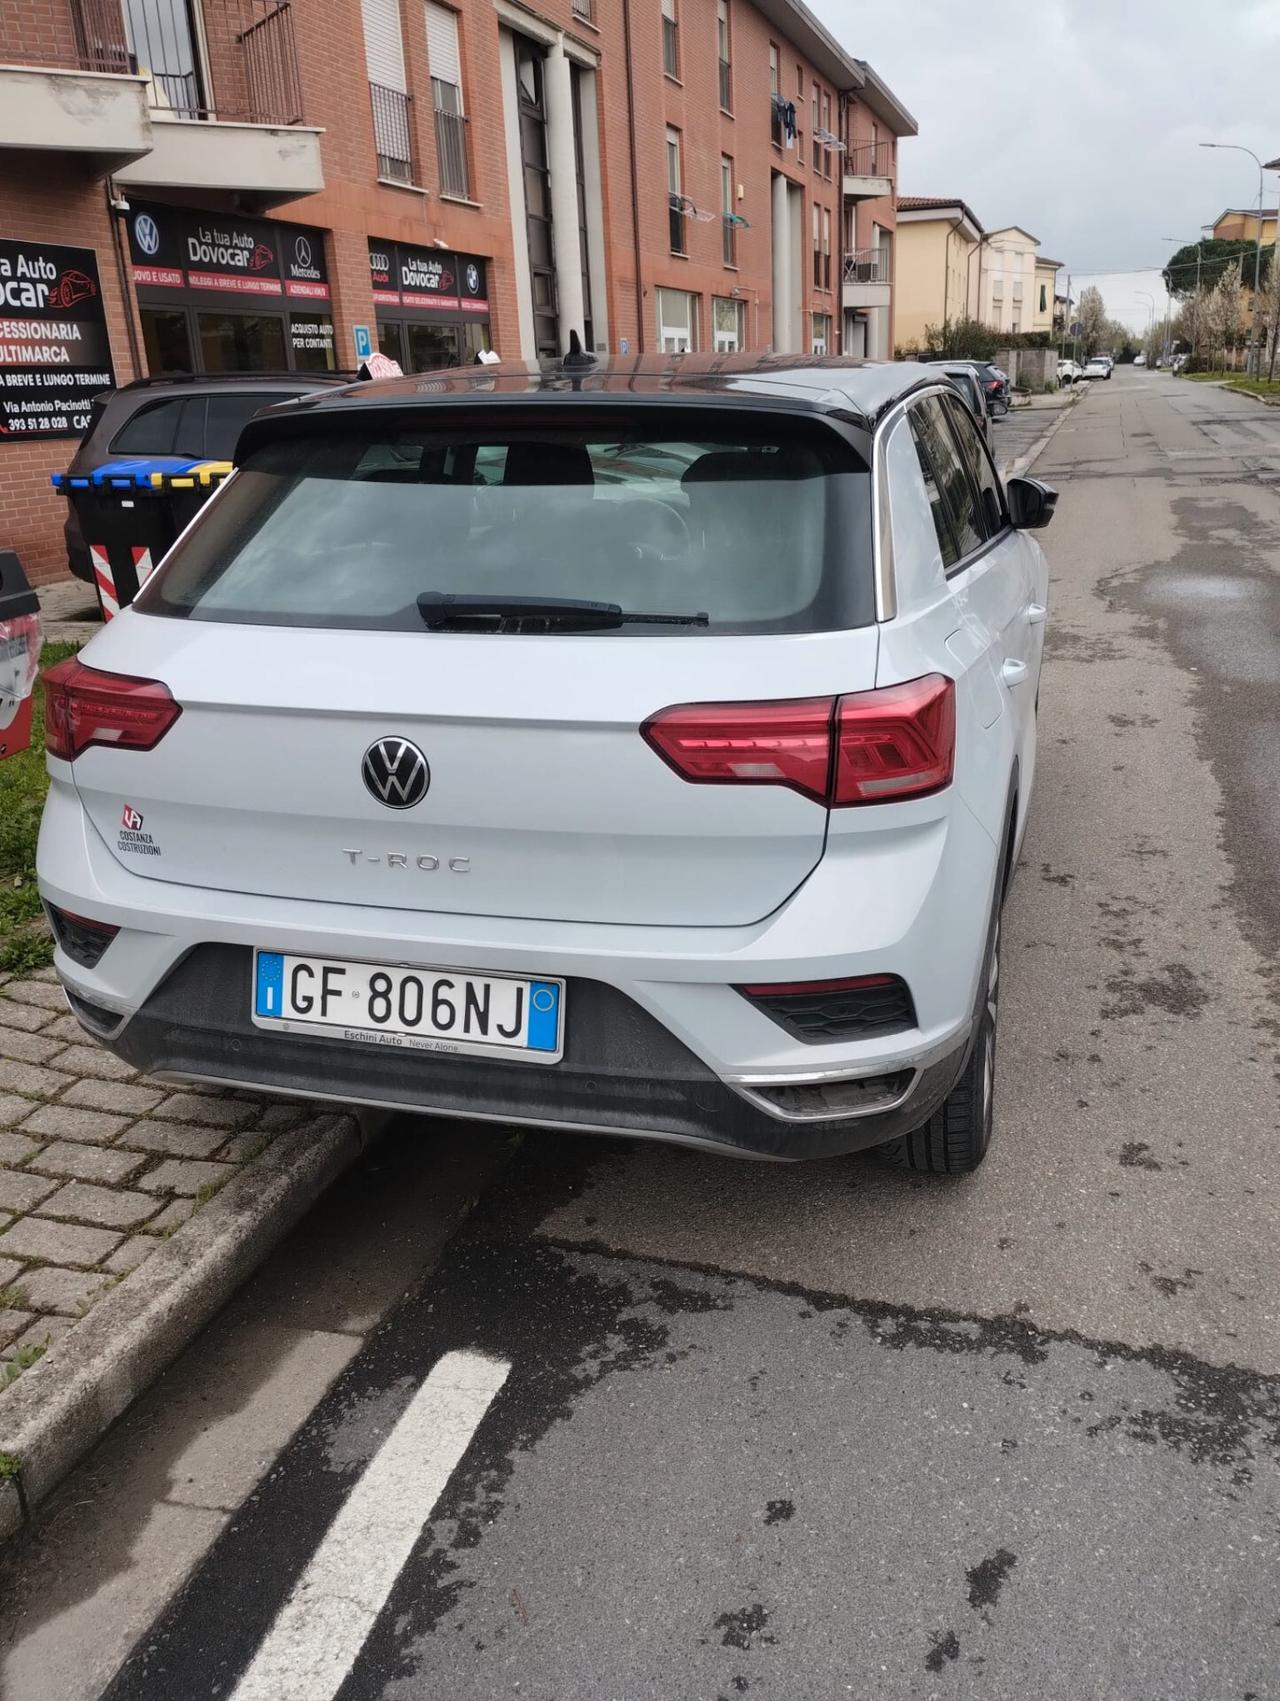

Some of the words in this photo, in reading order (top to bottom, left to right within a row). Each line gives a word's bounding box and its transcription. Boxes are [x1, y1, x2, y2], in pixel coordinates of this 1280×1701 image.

[199, 226, 212, 243] La
[214, 228, 230, 246] tua
[232, 231, 255, 249] Auto
[187, 237, 250, 267] Dovocar
[0, 258, 12, 277] a
[17, 254, 57, 280] Auto
[290, 263, 321, 279] Mercedes
[408, 257, 416, 271] La
[417, 259, 428, 272] tua
[428, 261, 442, 274] Auto
[152, 271, 158, 282] E
[158, 272, 181, 284] USATO
[401, 266, 440, 288] Dovocar
[0, 321, 82, 340] ESSIONARIA
[291, 323, 318, 335] ACQUISTO
[319, 324, 333, 336] AUTO
[292, 338, 305, 348] PER
[305, 338, 333, 348] CONTANTI
[358, 330, 367, 353] P
[6, 374, 35, 386] BREVE
[35, 374, 42, 386] E
[43, 373, 74, 386] LUNGO
[74, 373, 111, 385] TERMINE
[3, 401, 20, 413] Via
[21, 401, 54, 413] Antonio
[54, 399, 91, 411] Pacinotti
[8, 418, 26, 431] 393
[28, 418, 38, 430] 51
[39, 417, 50, 429] 28
[51, 416, 68, 428] 028
[120, 830, 154, 844] COSTANZA
[117, 840, 161, 856] COSTRUZIONI
[342, 848, 471, 873] T-ROC
[290, 963, 346, 1017] GF
[368, 972, 524, 1039] 806NJ
[344, 1030, 378, 1042] Eschini
[379, 1034, 402, 1045] Auto
[409, 1039, 433, 1049] Never
